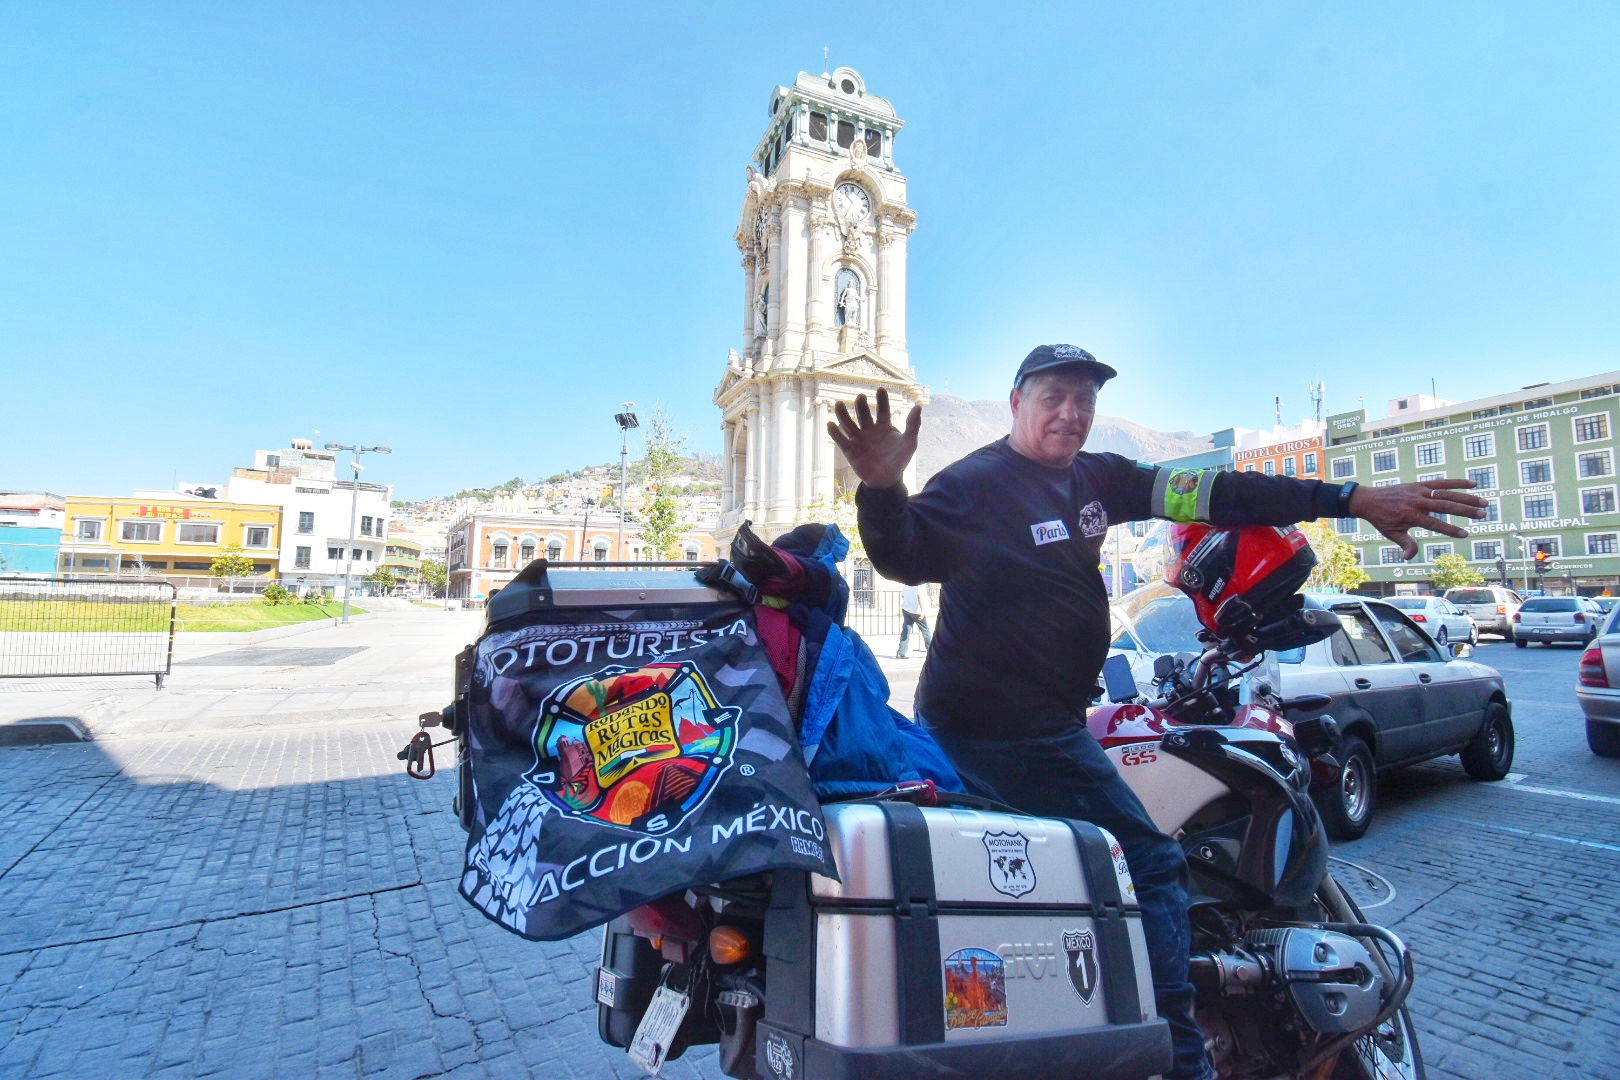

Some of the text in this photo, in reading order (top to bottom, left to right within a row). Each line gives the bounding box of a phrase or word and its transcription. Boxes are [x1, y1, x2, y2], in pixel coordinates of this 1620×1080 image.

[1332, 415, 1361, 426] EDIFICIO
[1345, 441, 1384, 452] INSTITUTO
[1399, 426, 1470, 443] ADMINISTRACION
[1473, 418, 1513, 430] PUBLICA
[1516, 414, 1529, 423] DE
[1533, 406, 1578, 420] HIDALGO
[1237, 440, 1310, 461] HOTEL CIROS
[1500, 485, 1554, 497] ECONOMICO
[1036, 524, 1067, 541] Paris
[1414, 529, 1429, 538] DE
[1520, 517, 1590, 530] MUNICIPAL
[1121, 750, 1157, 766] GS
[711, 802, 824, 845] MÉXICO
[1065, 936, 1091, 949] MEXICO
[1075, 951, 1089, 989] 1
